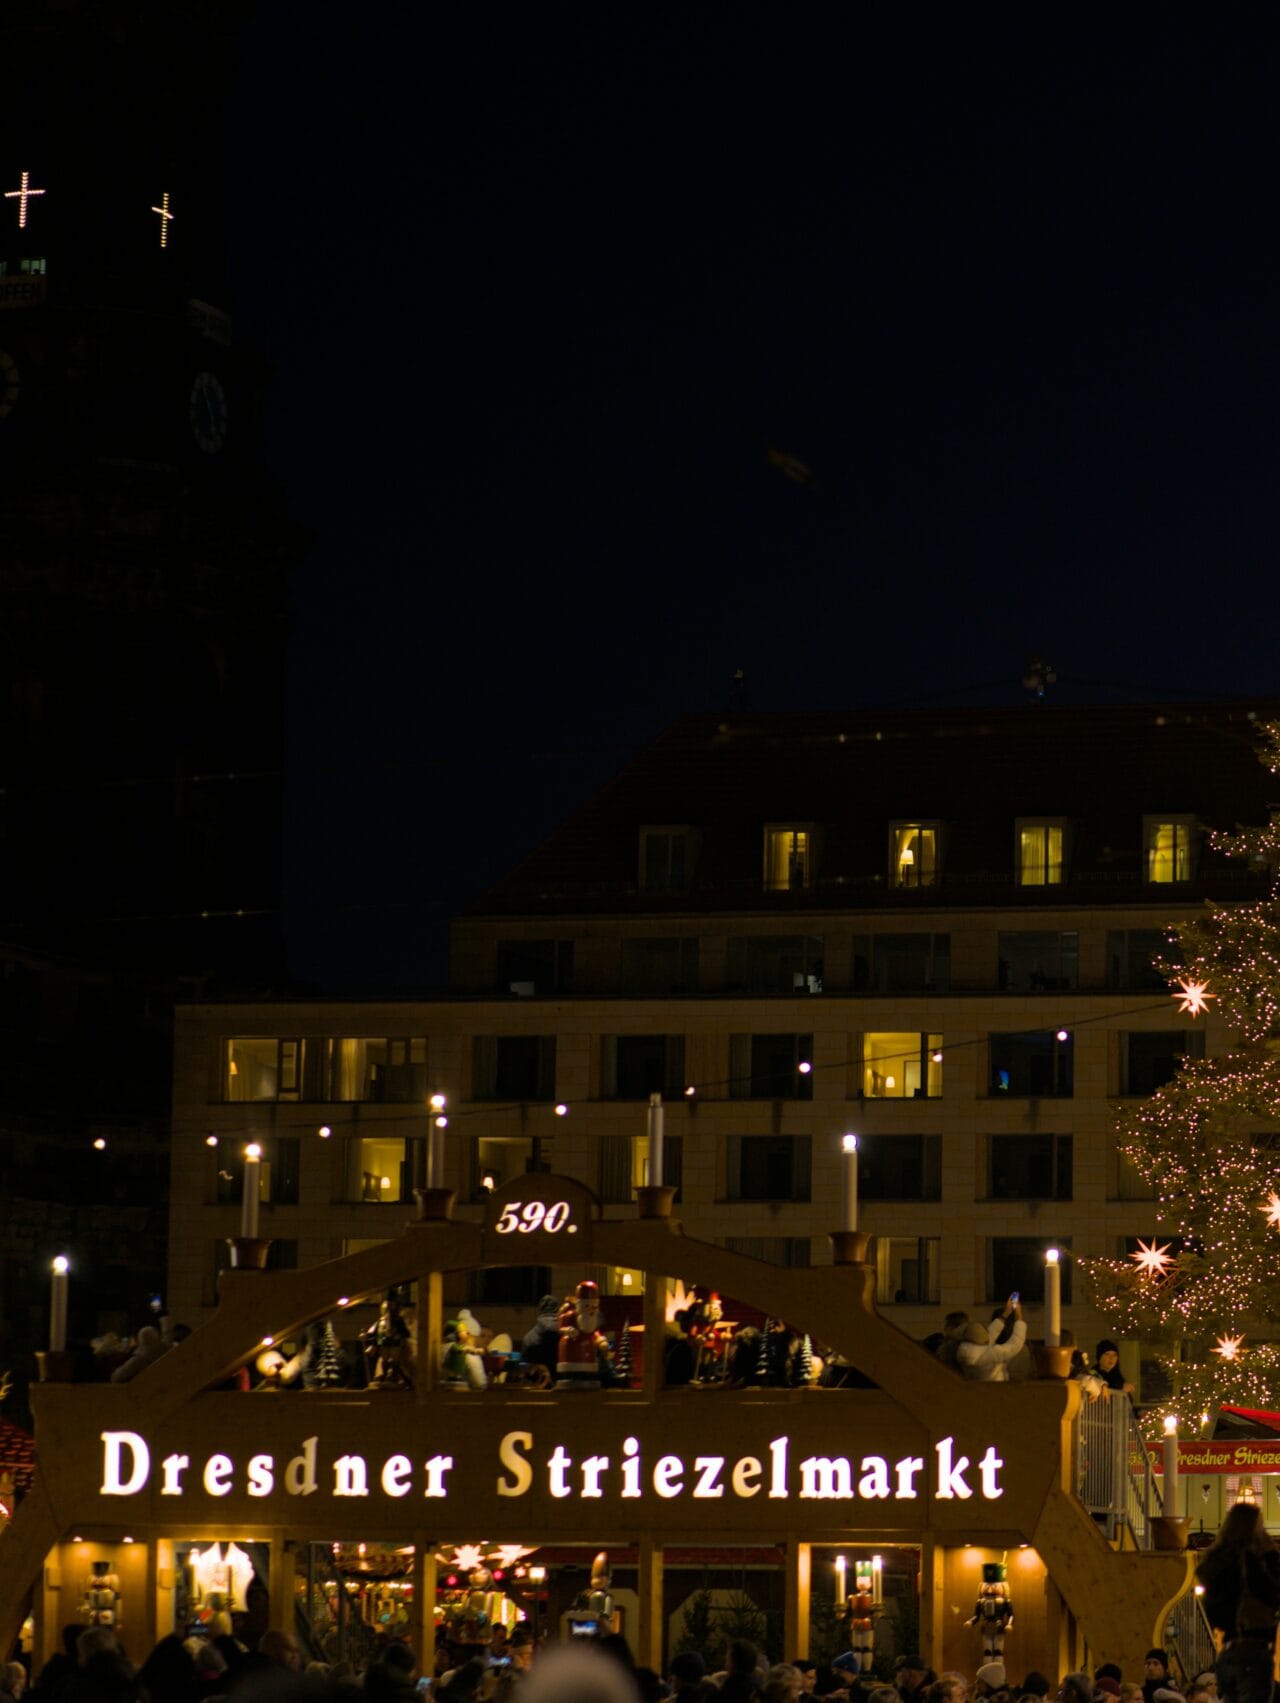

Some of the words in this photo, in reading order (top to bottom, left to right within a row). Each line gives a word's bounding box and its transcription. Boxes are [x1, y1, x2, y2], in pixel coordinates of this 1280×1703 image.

[494, 1201, 578, 1234] 590.
[100, 1431, 453, 1498] Dresdner
[496, 1430, 1004, 1500] Striezelmarkt
